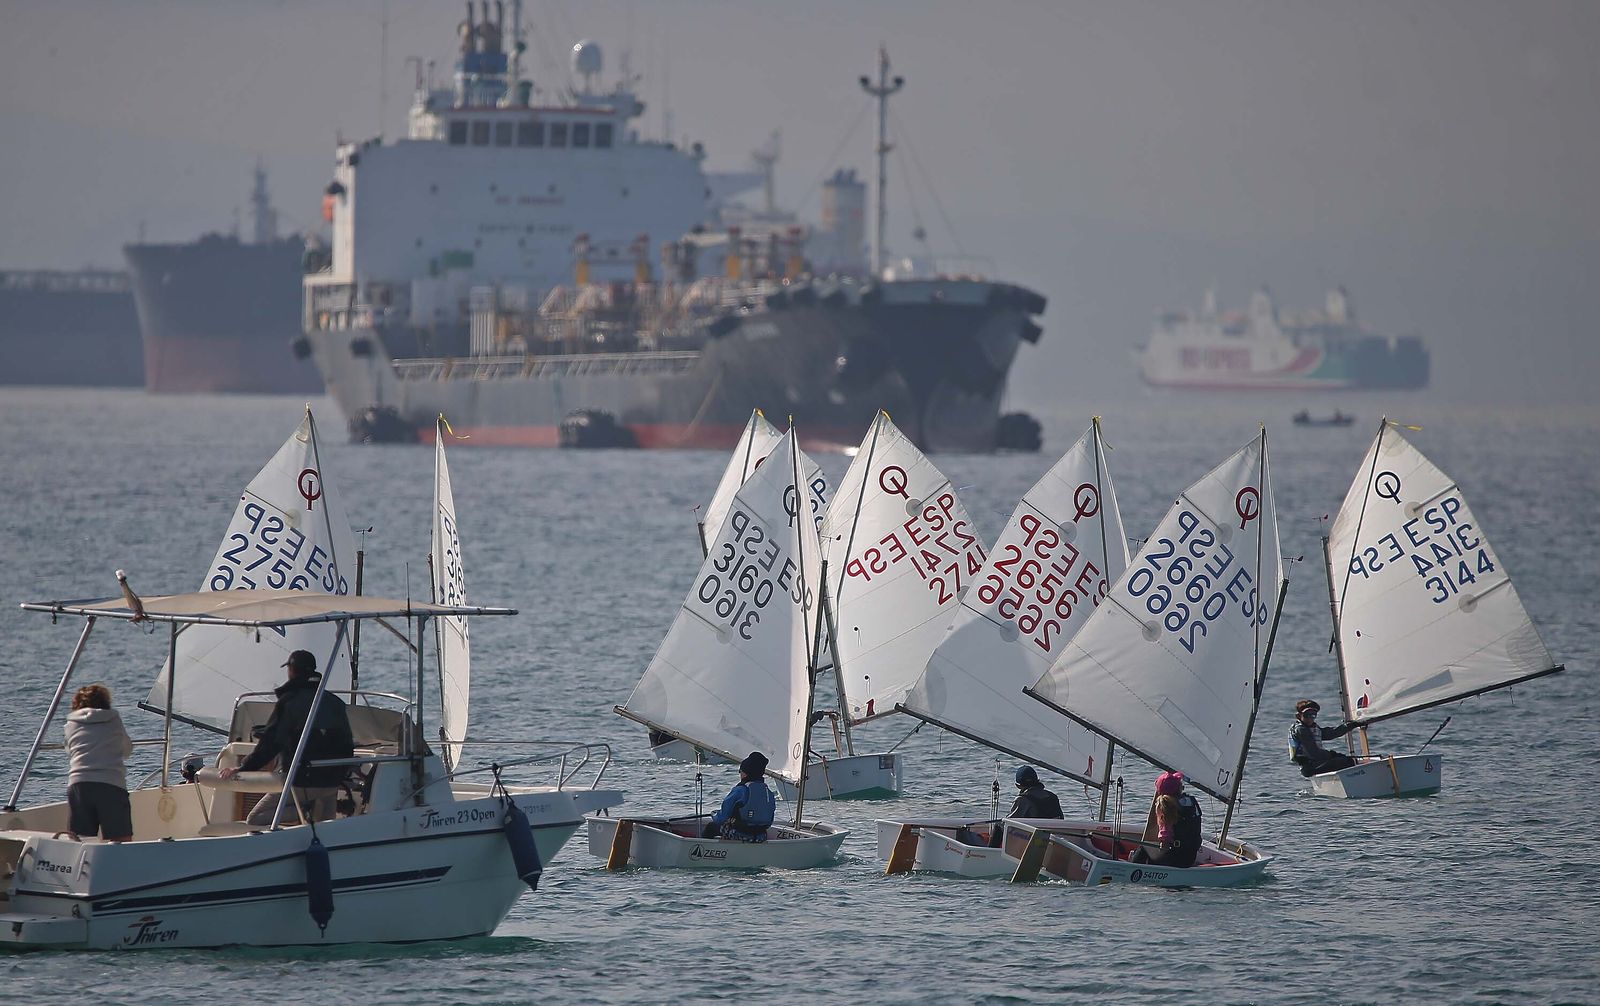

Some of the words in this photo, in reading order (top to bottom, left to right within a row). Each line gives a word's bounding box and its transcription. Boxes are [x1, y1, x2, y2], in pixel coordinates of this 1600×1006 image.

[903, 493, 954, 546] ESP
[1402, 497, 1461, 547] ESP
[714, 543, 774, 609] 3160
[777, 557, 812, 612] ESP
[929, 544, 987, 605] 2741
[993, 544, 1078, 619] 2656
[1075, 561, 1107, 607] ES
[1145, 538, 1226, 621] 2660
[1225, 567, 1268, 628] ESP
[1425, 549, 1495, 604] 3144
[420, 809, 455, 829] Thiren
[457, 810, 470, 823] 23
[471, 808, 495, 823] Open
[776, 830, 801, 840] ZERO
[703, 849, 728, 858] ZERO
[123, 917, 179, 945] Thiren
